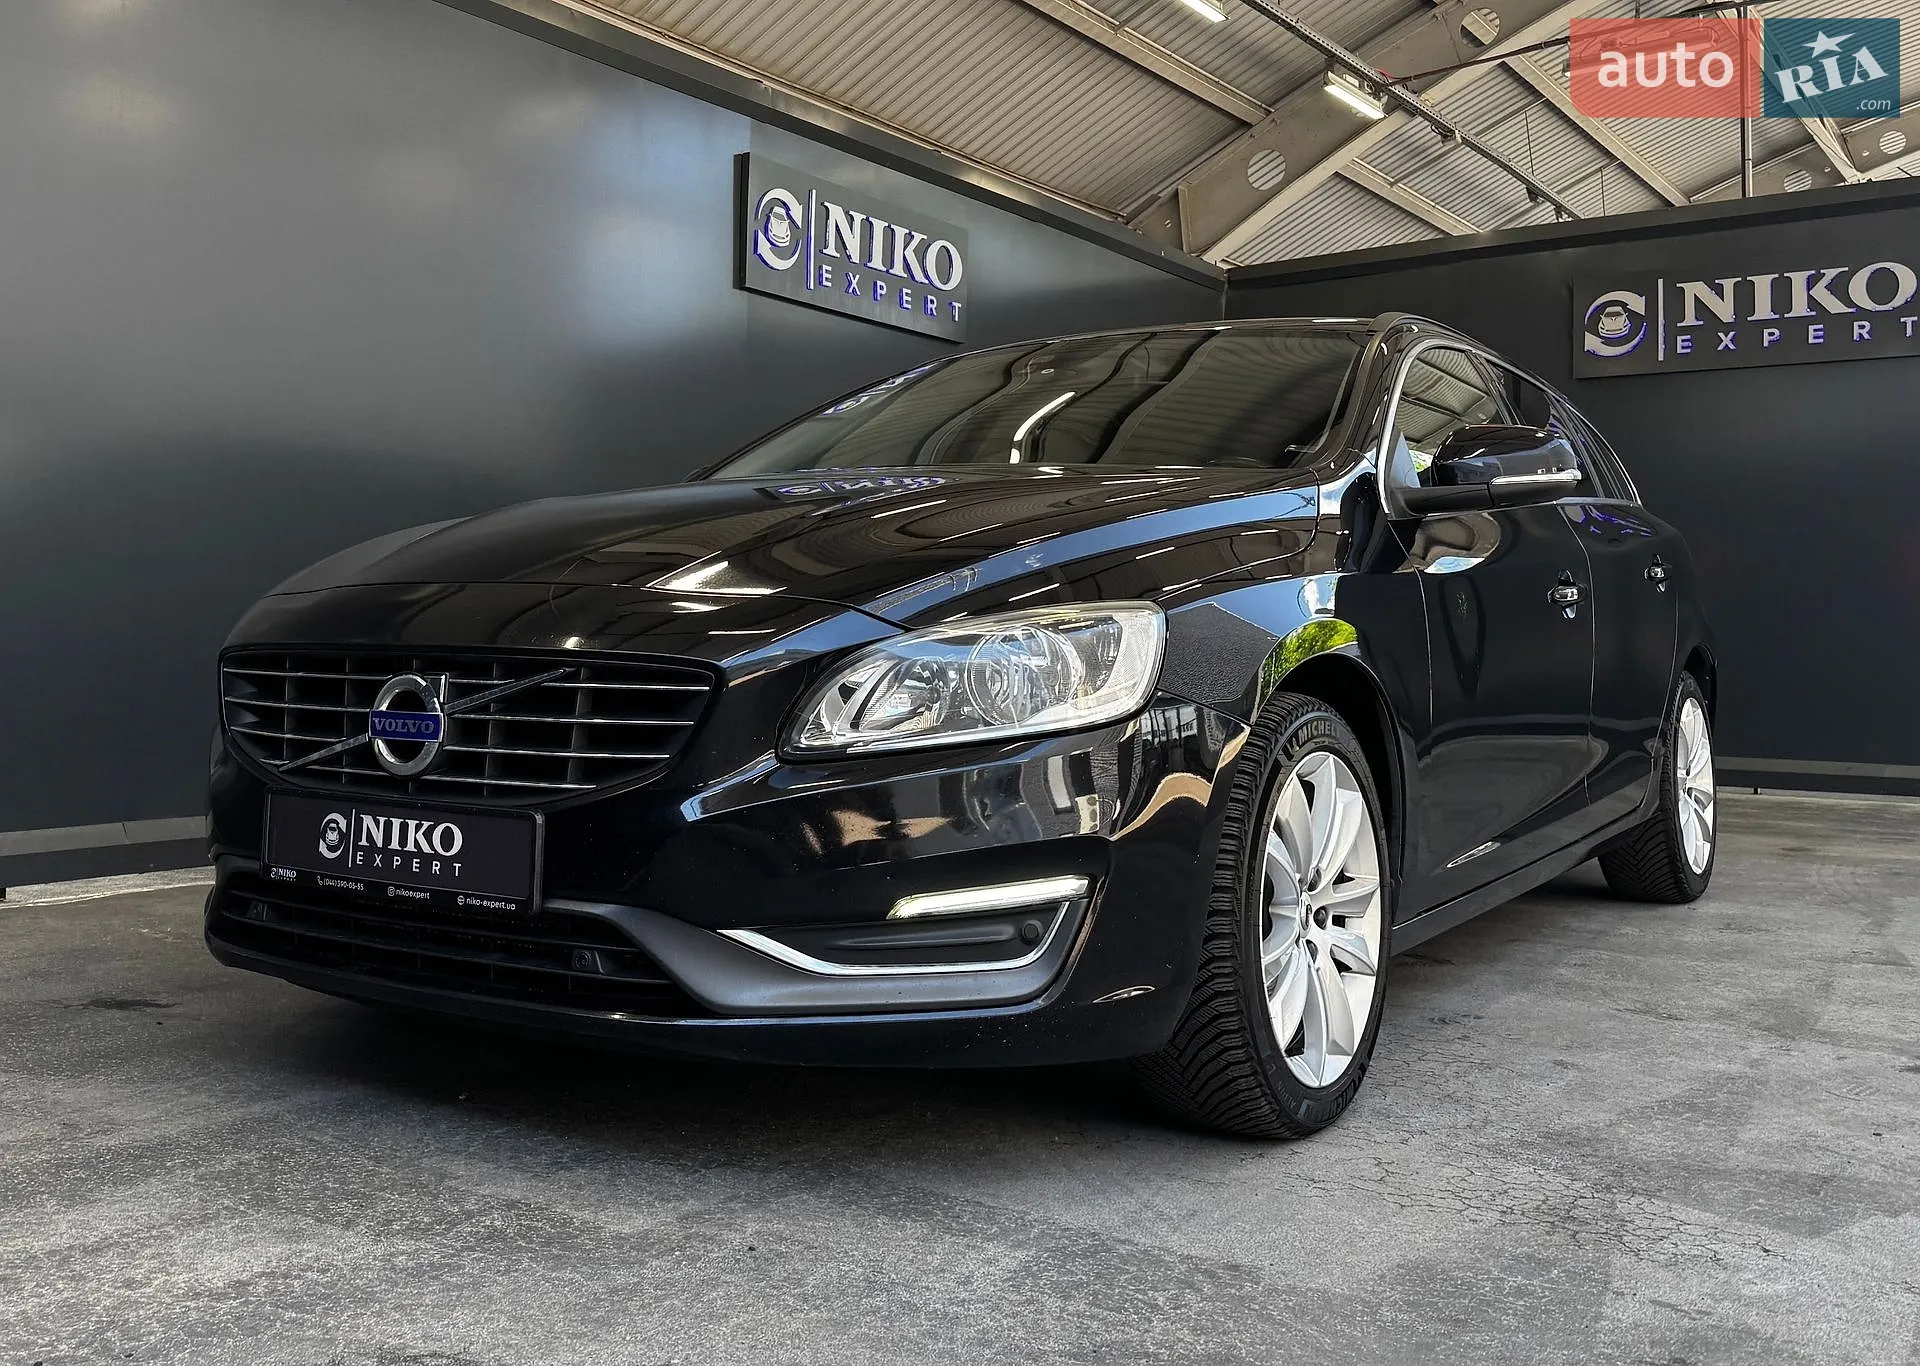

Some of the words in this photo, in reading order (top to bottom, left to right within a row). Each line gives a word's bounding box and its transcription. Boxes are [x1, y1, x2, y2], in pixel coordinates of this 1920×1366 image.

[819, 201, 963, 291] NIKO
[818, 264, 962, 322] EXPERT
[1676, 261, 1918, 327] NIKO
[1676, 316, 1919, 354] EXPERT
[372, 717, 435, 734] VOLVO
[357, 814, 463, 857] NIKO
[278, 867, 297, 878] NIKO
[356, 851, 462, 877] EXPERT
[395, 888, 430, 900] nikoexpert
[466, 897, 516, 911] niko-expert.ua
